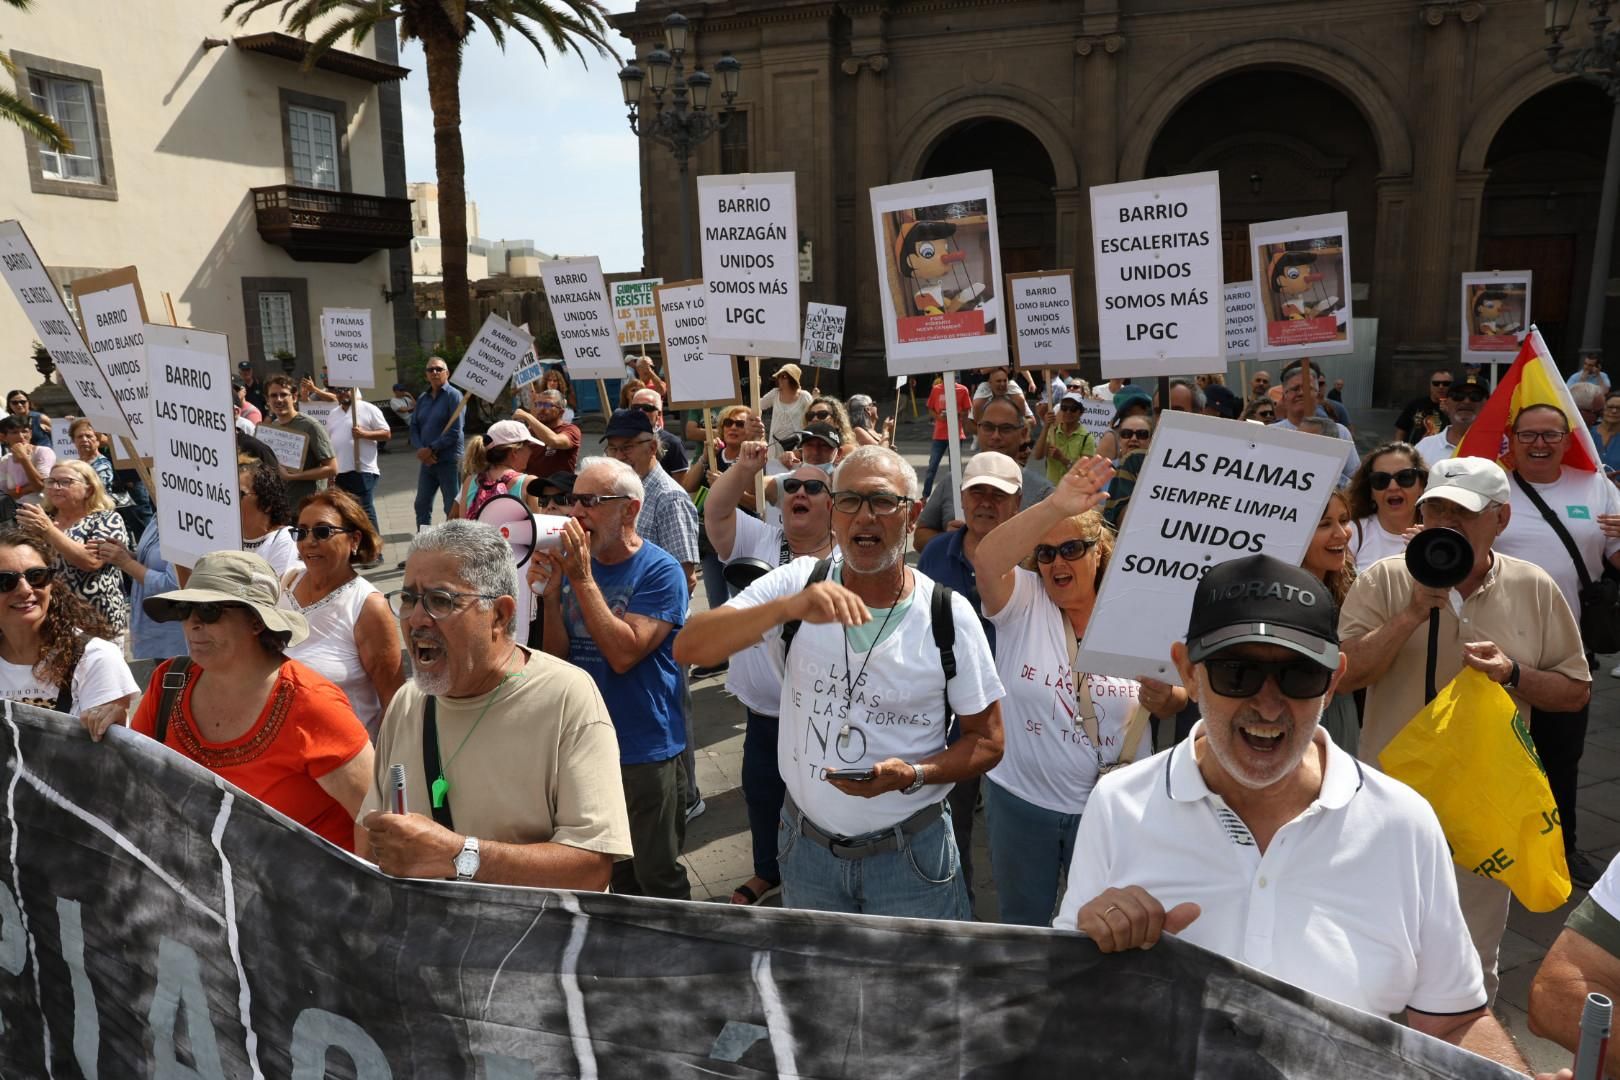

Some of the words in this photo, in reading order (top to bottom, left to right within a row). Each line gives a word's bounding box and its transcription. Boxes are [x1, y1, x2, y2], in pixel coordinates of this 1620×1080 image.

[718, 198, 770, 213] BARRIO
[1119, 202, 1188, 223] BARRIO
[706, 223, 787, 241] MARZAGÁN
[1101, 231, 1210, 254] ESCALERITAS
[2, 252, 32, 272] BARRIO
[720, 255, 774, 268] UNIDOS
[554, 273, 588, 286] BARRIO
[1120, 262, 1191, 282] UNIDOS
[20, 288, 35, 303] EL
[710, 281, 755, 294] SOMOS
[759, 279, 788, 295] MÁS
[1025, 287, 1057, 297] BARRIO
[551, 290, 602, 305] MARZAGÁN
[615, 293, 651, 307] RESISTE
[661, 302, 685, 312] MESA
[686, 300, 691, 309] Y
[693, 297, 705, 308] LÓ
[1015, 300, 1038, 310] LOMO
[1039, 299, 1070, 309] BLANCO
[1105, 293, 1166, 310] SOMOS
[1170, 288, 1209, 306] MÁS
[563, 310, 598, 322] UNIDOS
[726, 308, 766, 324] LPGC
[1226, 303, 1256, 313] CARDO
[96, 309, 128, 327] BARRIO
[336, 318, 365, 326] PALMAS
[675, 316, 707, 329] UNIDO
[1027, 313, 1060, 323] UNIDOS
[40, 319, 71, 336] UNIDOS
[335, 330, 362, 338] UNIDOS
[561, 328, 591, 340] SOMOS
[591, 325, 610, 337] MÁS
[1019, 327, 1050, 337] SOMOS
[1051, 324, 1070, 335] MÁS
[1125, 322, 1179, 341] LPGC
[1225, 328, 1244, 336] MOS
[91, 339, 115, 355] LOMO
[115, 332, 144, 350] BLANCO
[353, 341, 369, 350] MÁS
[491, 329, 518, 348] BARRIO
[667, 335, 700, 347] SOMOS
[1034, 340, 1053, 349] LPGC
[1227, 339, 1250, 349] LPGC
[479, 336, 517, 361] ATLÁNTICO
[575, 347, 601, 359] LPGC
[684, 352, 704, 362] LPGC
[338, 354, 359, 362] LPGC
[478, 349, 505, 368] UNIDOS
[107, 360, 141, 377] UNIDOS
[466, 356, 490, 373] SOMOS
[489, 368, 505, 381] MÁS
[165, 365, 212, 391] BARRIO
[466, 370, 488, 386] LPGC
[75, 380, 102, 400] LPGC
[115, 387, 136, 403] MOS
[127, 413, 144, 425] PGC
[155, 400, 179, 424] LAS
[181, 405, 227, 432] TORRES
[1083, 408, 1110, 416] BARRIO
[170, 439, 218, 468] UNIDOS
[1162, 448, 1208, 473] LAS
[1212, 455, 1315, 492] PALMAS
[161, 471, 204, 500] SOMOS
[206, 480, 232, 506] MÁS
[1149, 484, 1233, 511] SIEMPRE
[1234, 497, 1298, 523] LIMPIA
[177, 510, 215, 540] LPGC
[1160, 518, 1266, 553] UNIDOS
[1207, 581, 1317, 607] MORATO
[830, 663, 869, 687] LAS
[1021, 664, 1037, 681] DE
[1045, 674, 1073, 695] LAS
[1059, 664, 1108, 682] CAAS
[814, 679, 881, 708] CASAS
[813, 698, 848, 719] LAS
[864, 710, 932, 727] TORRES
[1026, 719, 1042, 736] SE
[804, 716, 867, 764] NO
